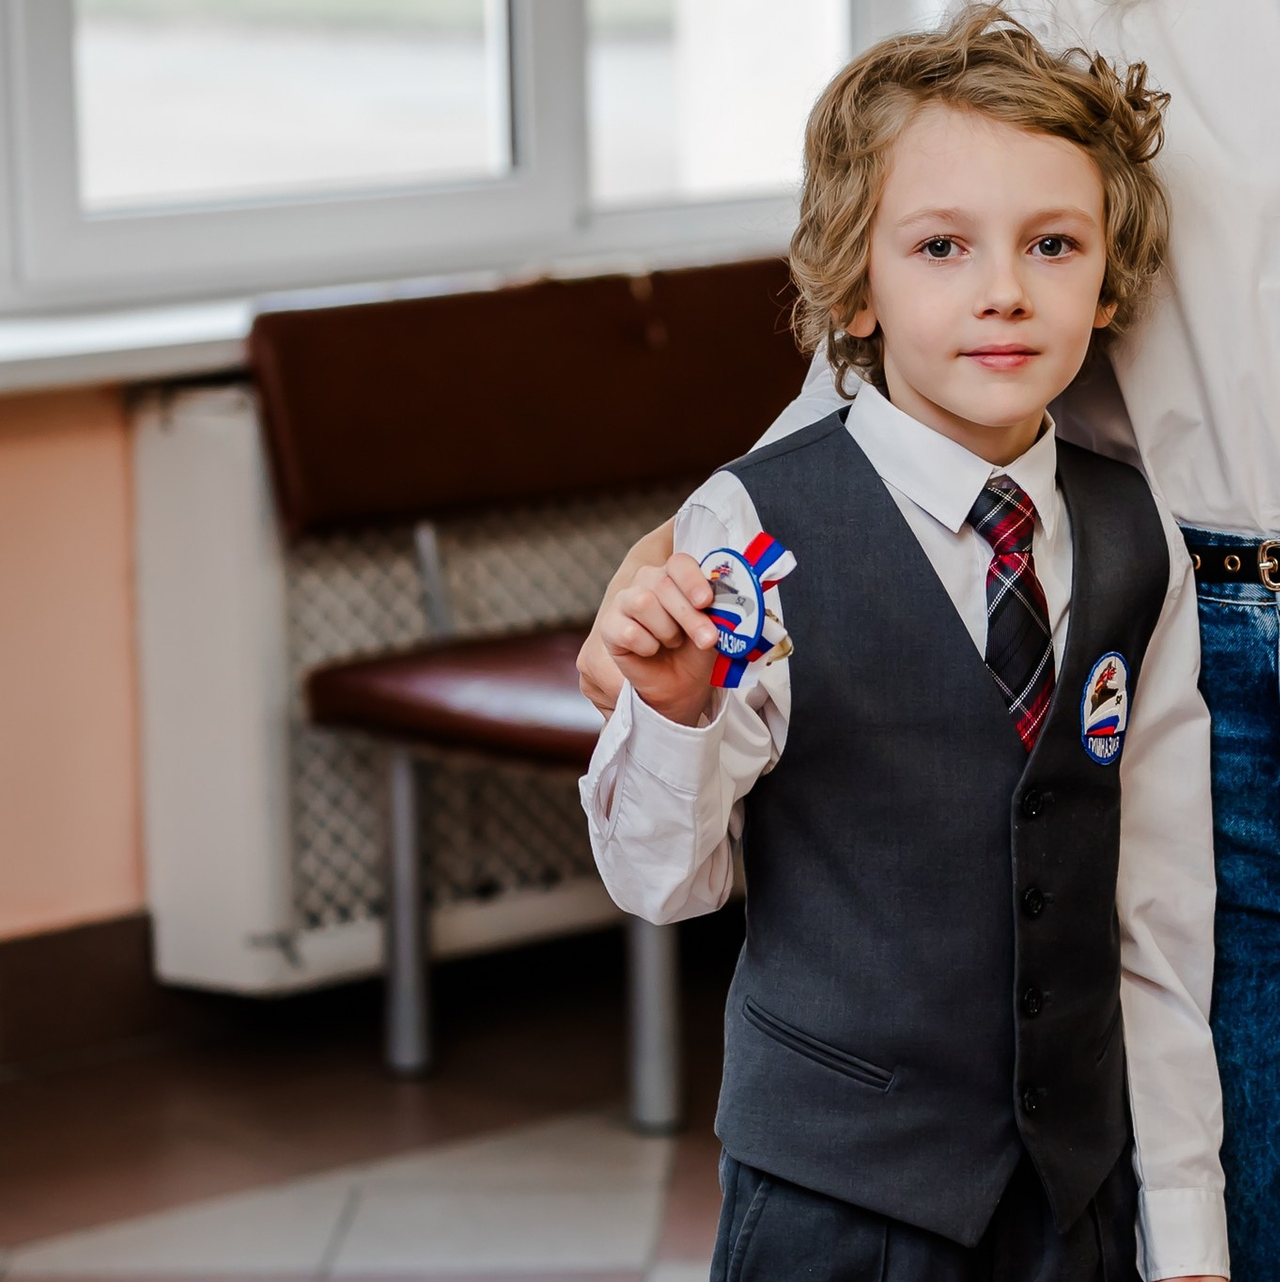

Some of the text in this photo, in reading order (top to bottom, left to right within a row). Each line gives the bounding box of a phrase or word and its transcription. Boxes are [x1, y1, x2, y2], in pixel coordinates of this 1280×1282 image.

[735, 595, 746, 606] 52
[717, 629, 747, 654] НАЗИЯ
[1088, 736, 1120, 758] ГИМНАЗИЯ
